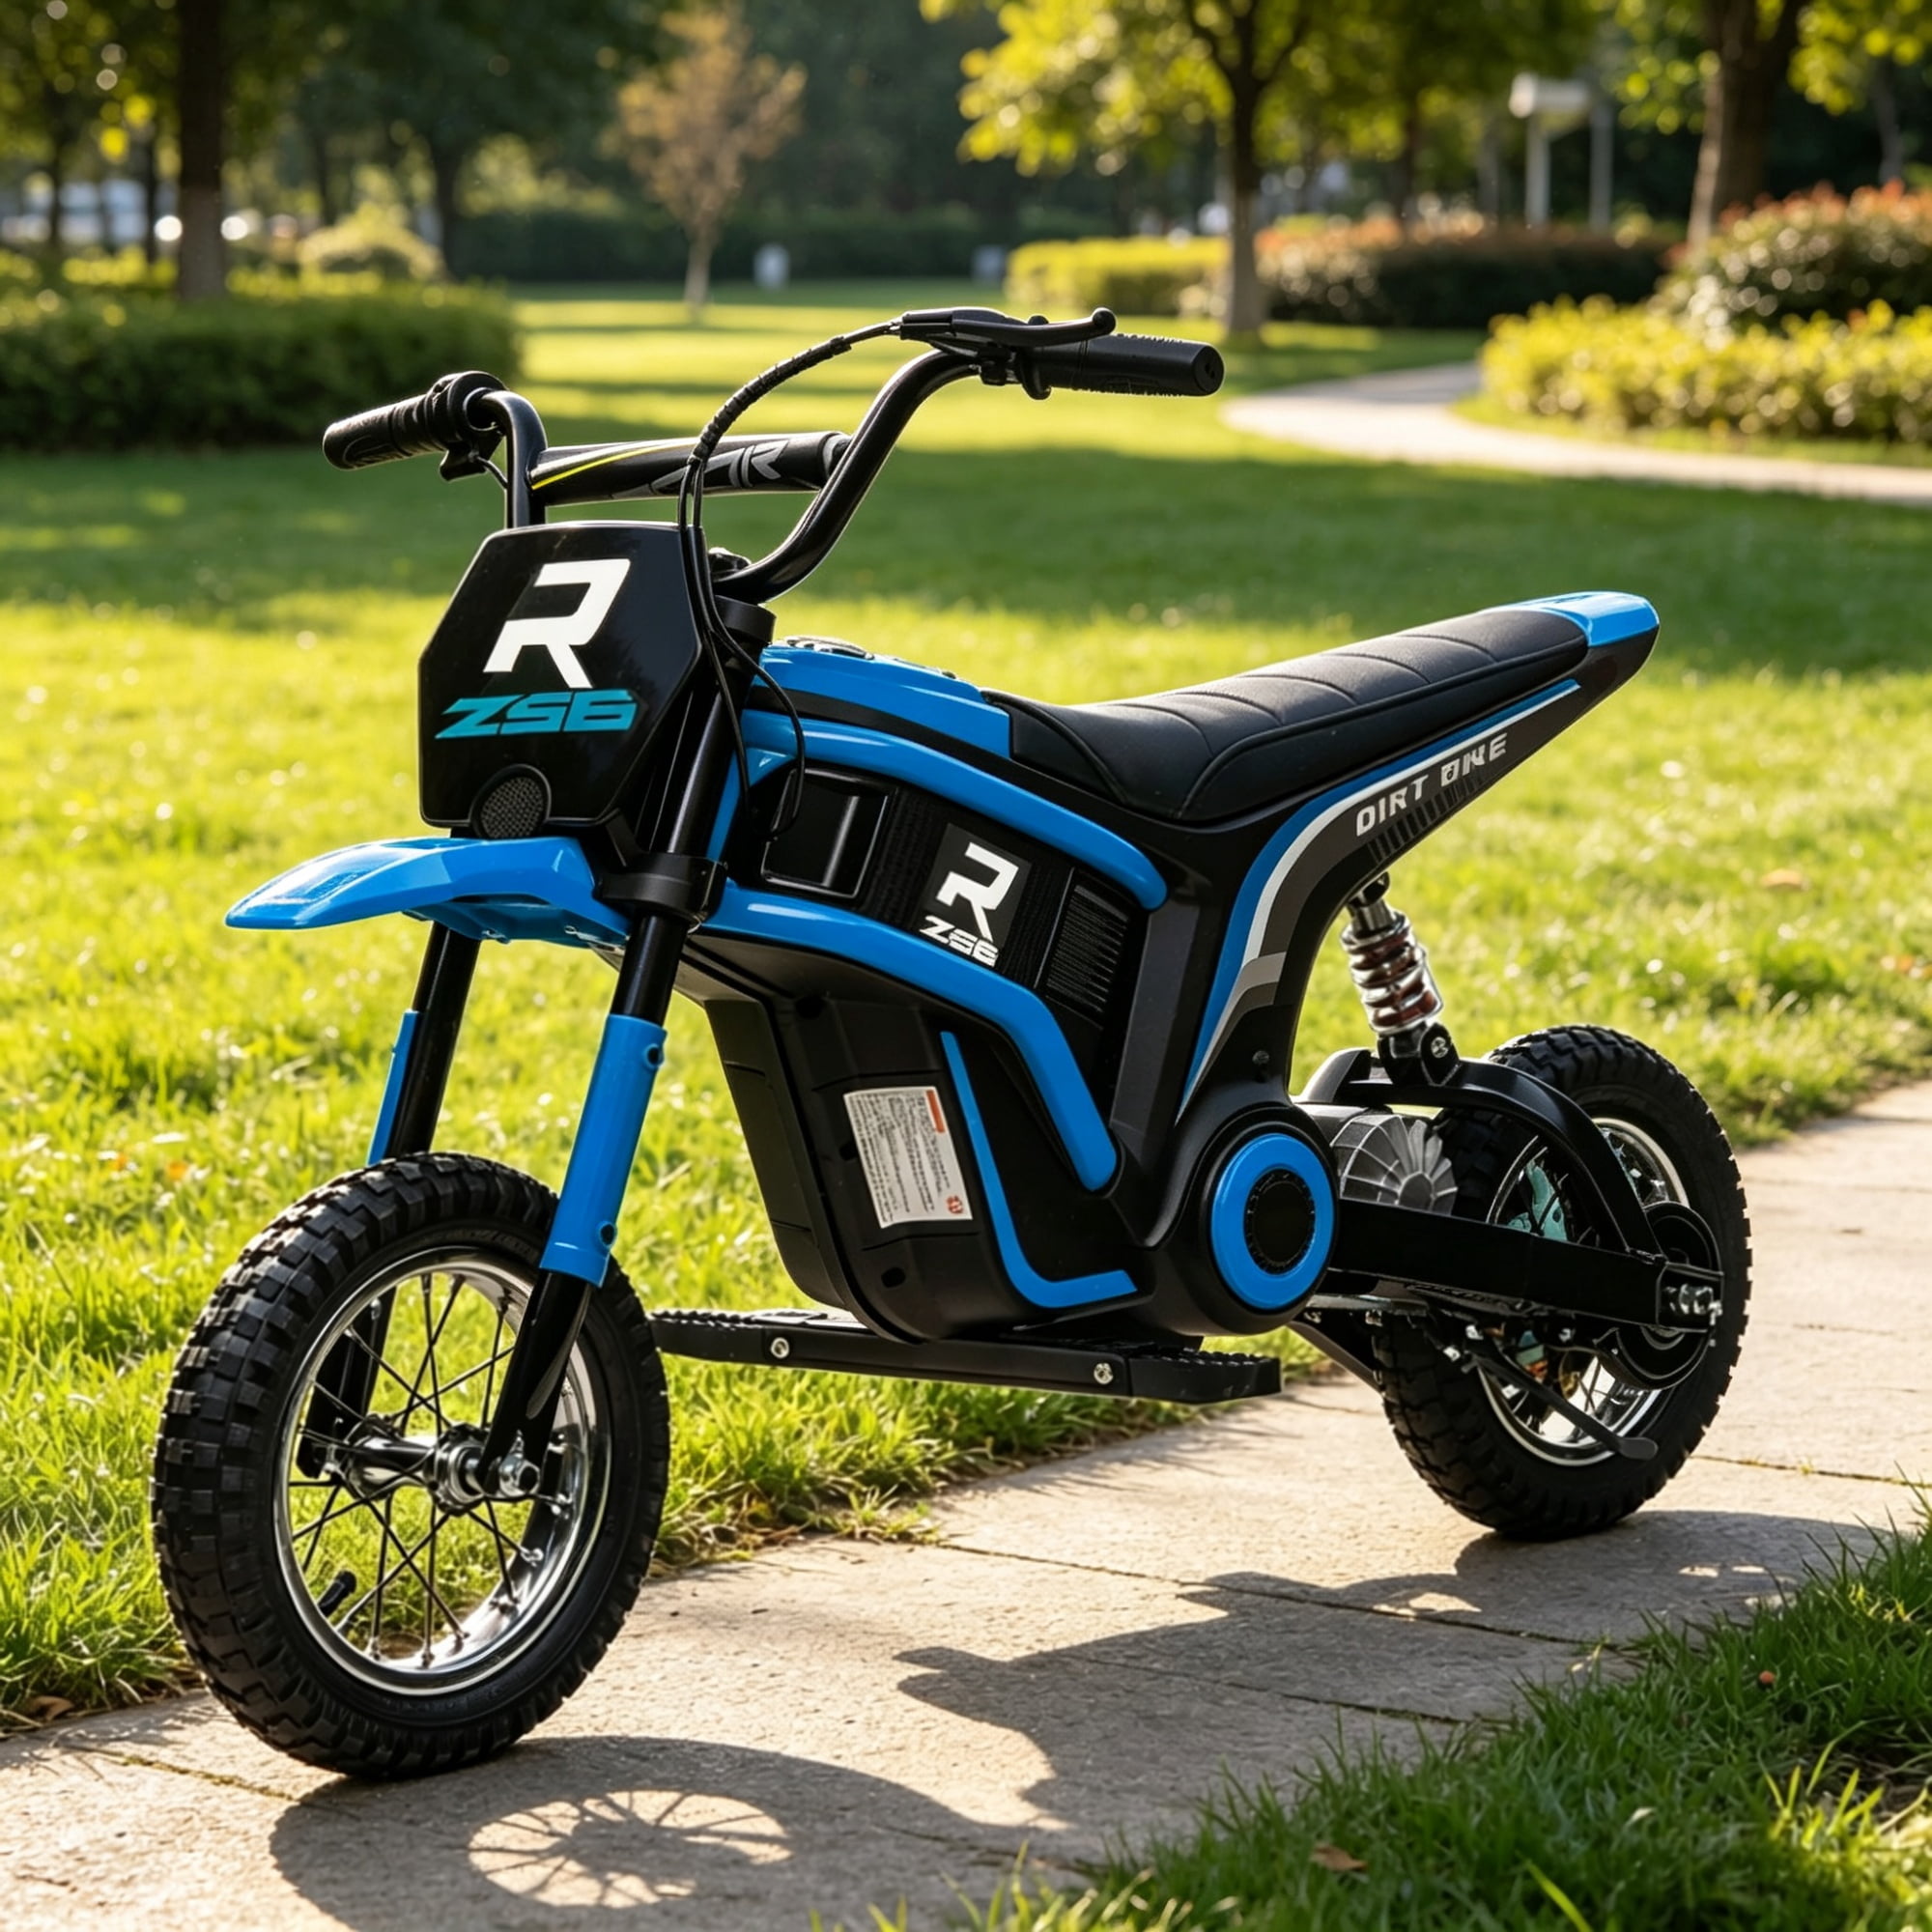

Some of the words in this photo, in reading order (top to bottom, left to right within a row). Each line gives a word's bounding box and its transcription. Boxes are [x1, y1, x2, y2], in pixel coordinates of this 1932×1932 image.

[483, 558, 631, 689] R
[435, 689, 637, 739] ZS6
[1355, 774, 1429, 837] DIRT
[935, 841, 1019, 943] R
